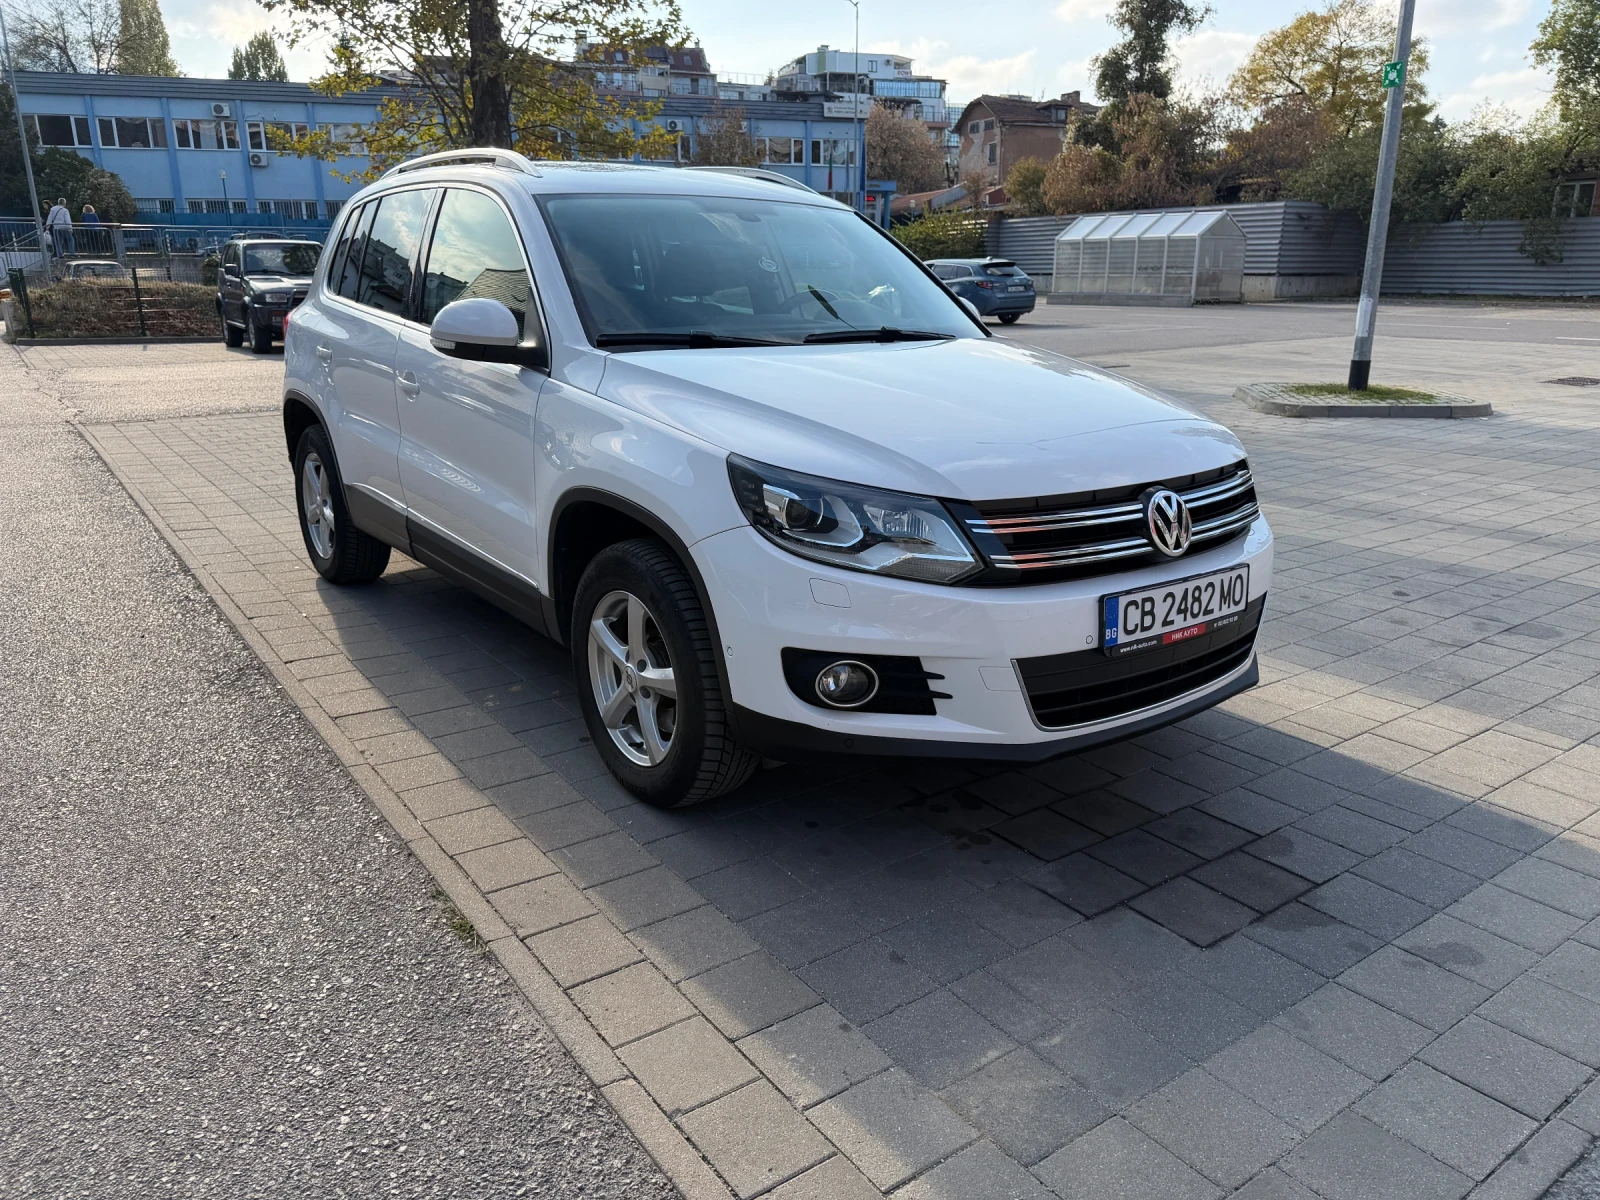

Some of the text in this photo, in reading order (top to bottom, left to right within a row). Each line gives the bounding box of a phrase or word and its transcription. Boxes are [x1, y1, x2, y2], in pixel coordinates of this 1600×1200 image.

[1123, 573, 1244, 636] CB 2482 MO
[1105, 627, 1117, 640] BG
